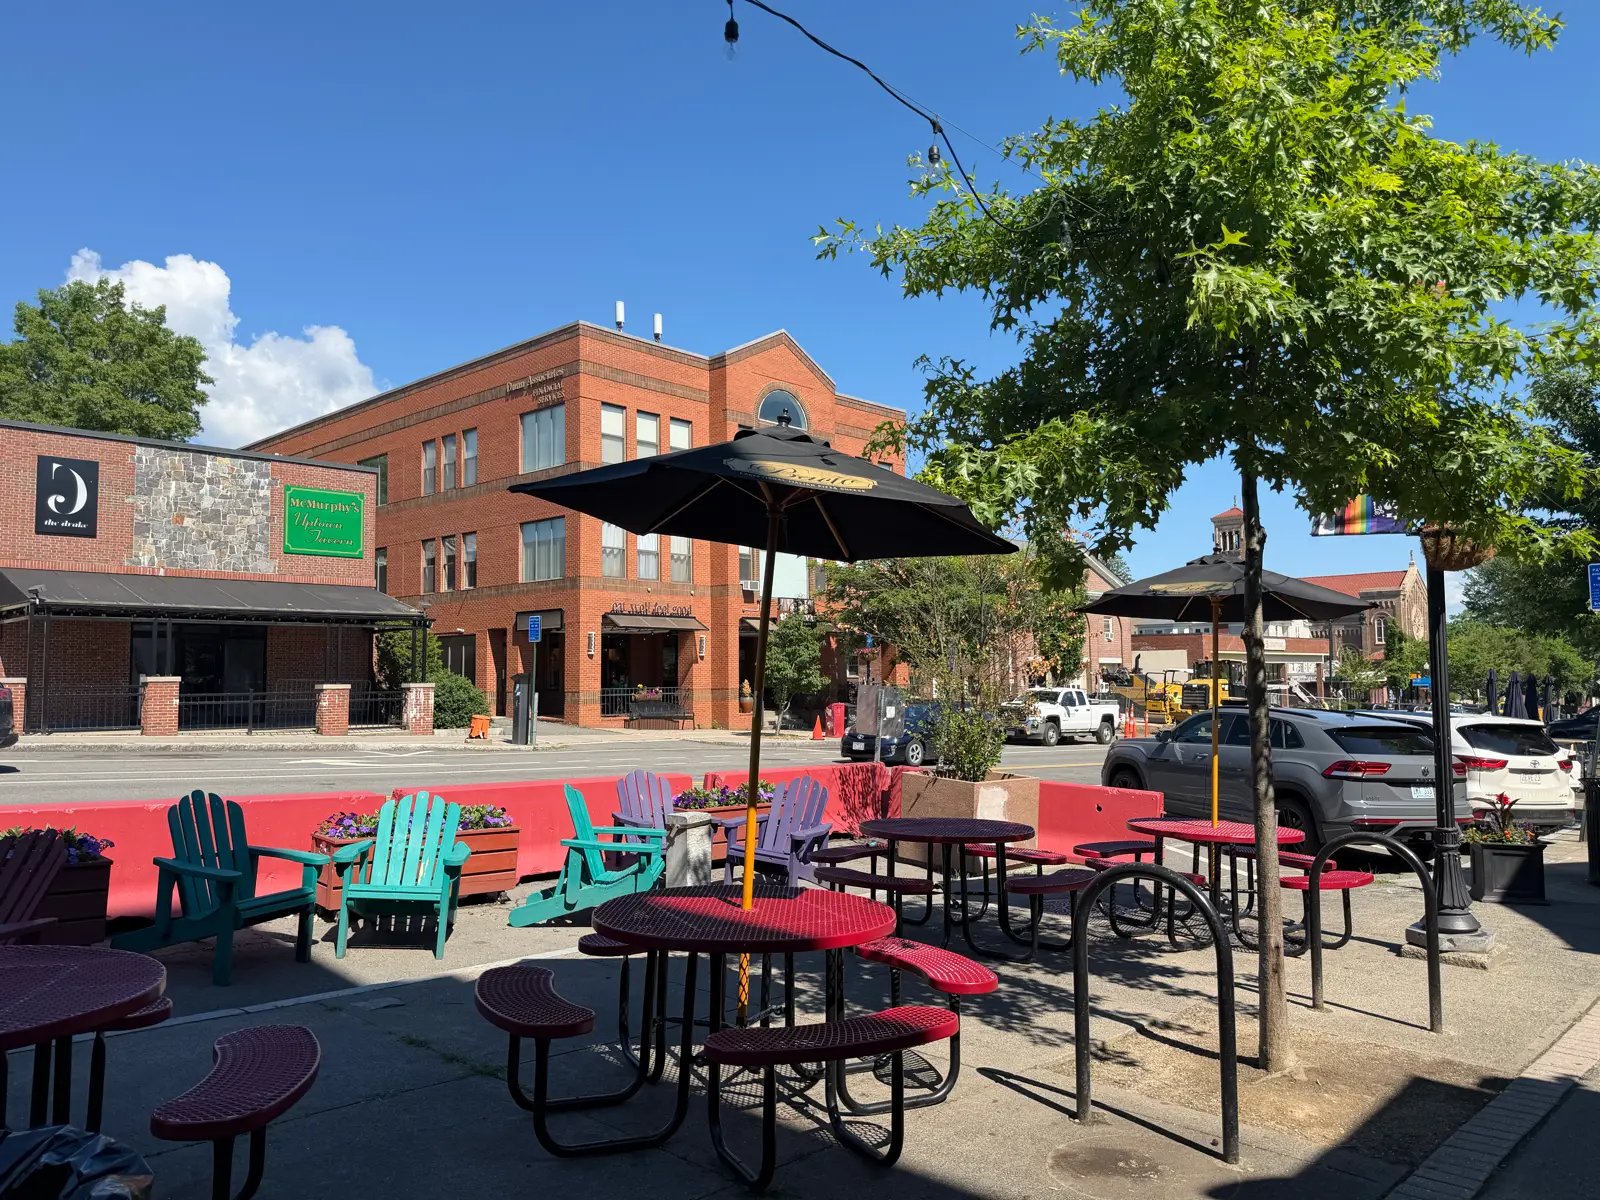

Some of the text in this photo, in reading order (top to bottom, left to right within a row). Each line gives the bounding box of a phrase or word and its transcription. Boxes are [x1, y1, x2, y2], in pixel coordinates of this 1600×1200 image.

[532, 380, 565, 397] FINANCIAL
[537, 390, 565, 404] SERVICES
[290, 497, 360, 515] McMurphy's
[44, 518, 88, 529] the drake
[294, 511, 343, 530] Uptown
[304, 529, 353, 545] Tavern
[611, 602, 625, 613] eat
[670, 604, 692, 617] good
